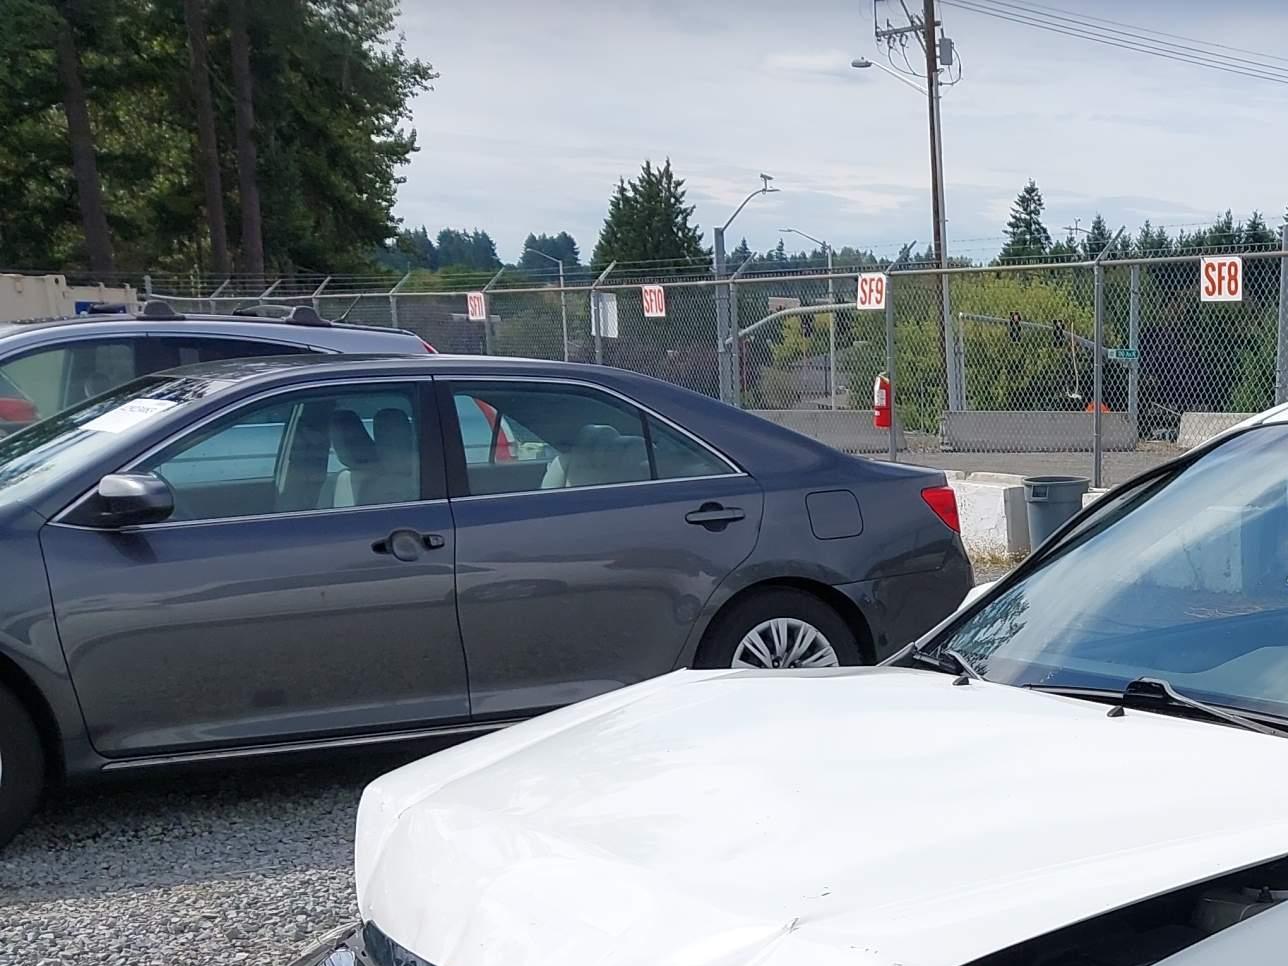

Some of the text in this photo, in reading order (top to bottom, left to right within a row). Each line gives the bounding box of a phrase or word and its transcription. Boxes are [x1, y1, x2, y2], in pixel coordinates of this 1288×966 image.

[860, 277, 883, 305] SF9
[1205, 261, 1238, 296] SF8
[469, 295, 485, 316] SF11
[644, 289, 664, 313] SF10
